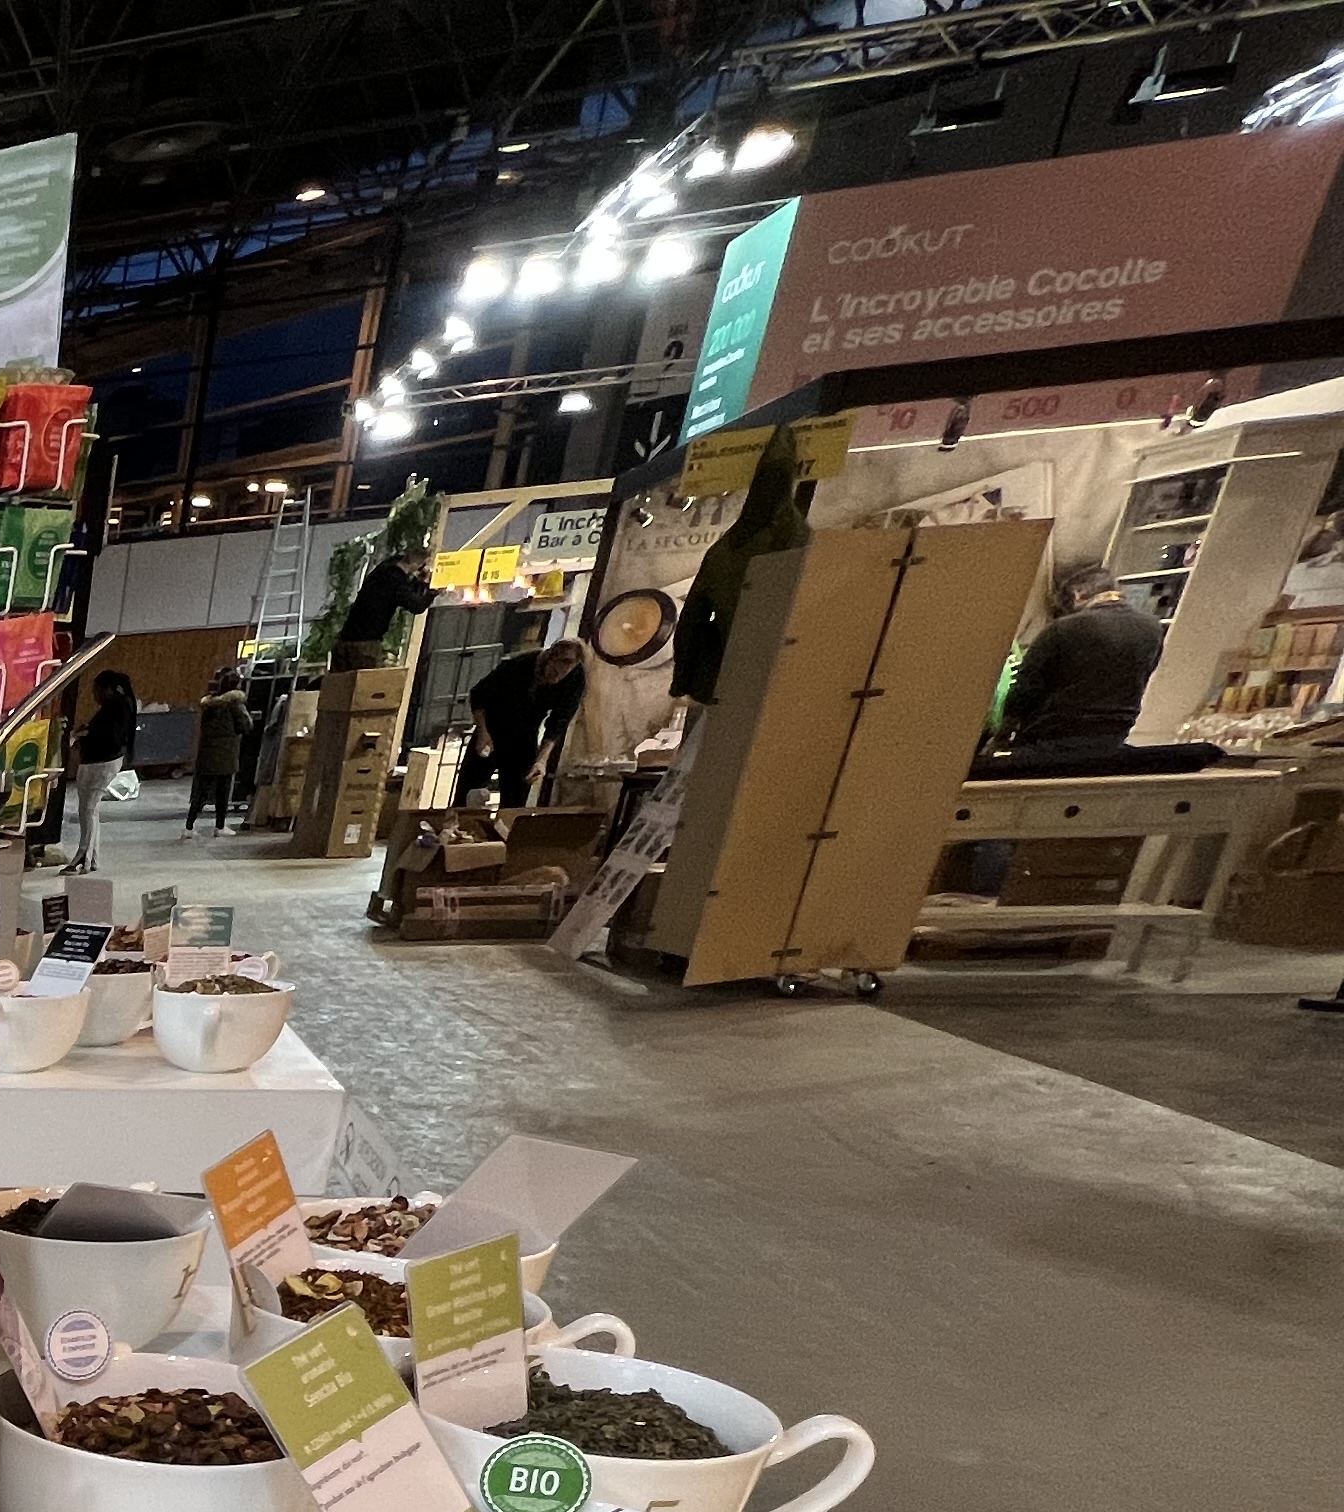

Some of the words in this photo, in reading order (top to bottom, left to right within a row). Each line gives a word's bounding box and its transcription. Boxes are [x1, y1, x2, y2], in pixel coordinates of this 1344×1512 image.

[1027, 257, 1167, 296] Cocotte
[802, 329, 833, 353] et
[842, 322, 904, 350] ses
[912, 297, 1125, 341] accessoires
[655, 531, 723, 548] SECOU
[509, 1466, 560, 1496] BIO
